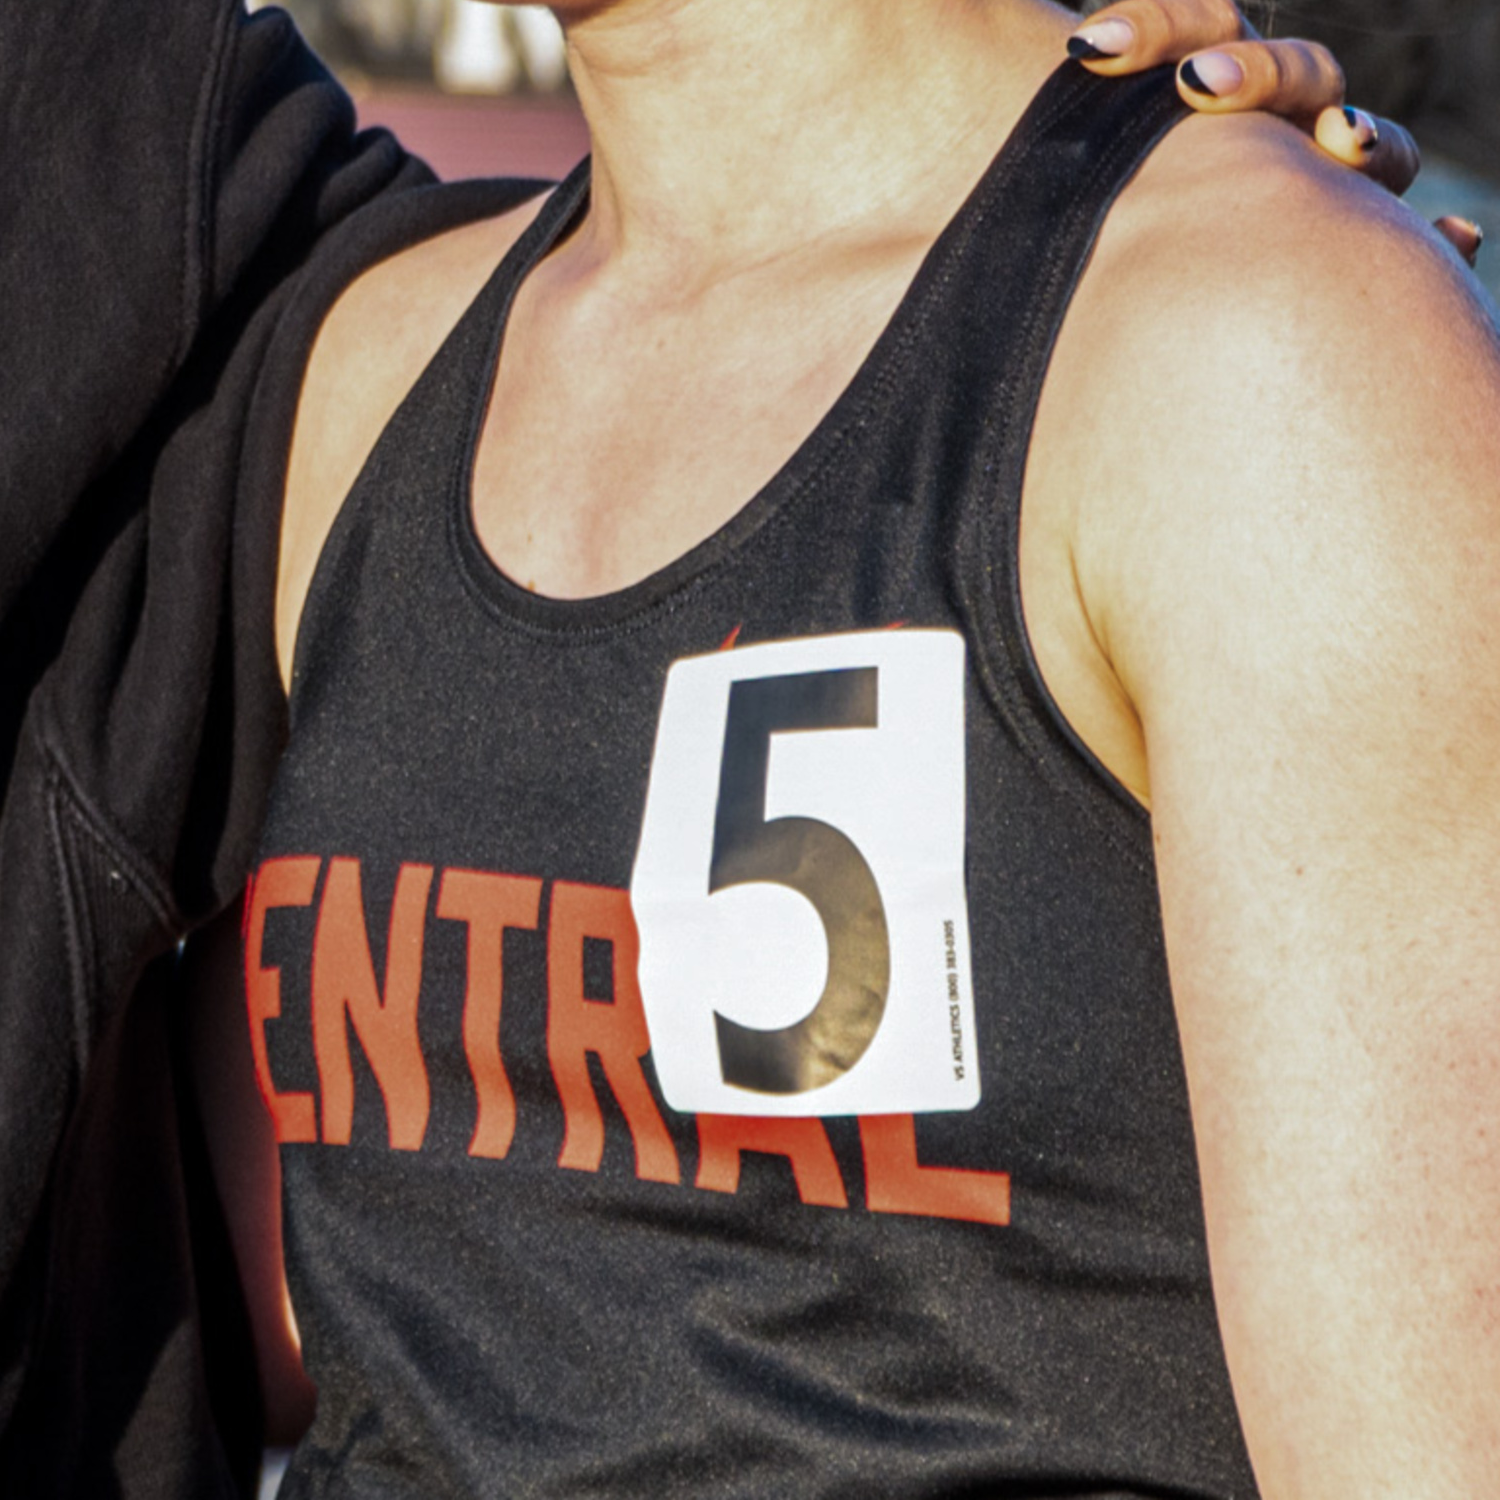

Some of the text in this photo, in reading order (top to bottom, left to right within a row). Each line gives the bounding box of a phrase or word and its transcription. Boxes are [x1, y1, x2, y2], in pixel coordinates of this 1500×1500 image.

[707, 665, 891, 1097] 5
[949, 1004, 963, 1062] ATHLETICS
[954, 1065, 964, 1081] VS
